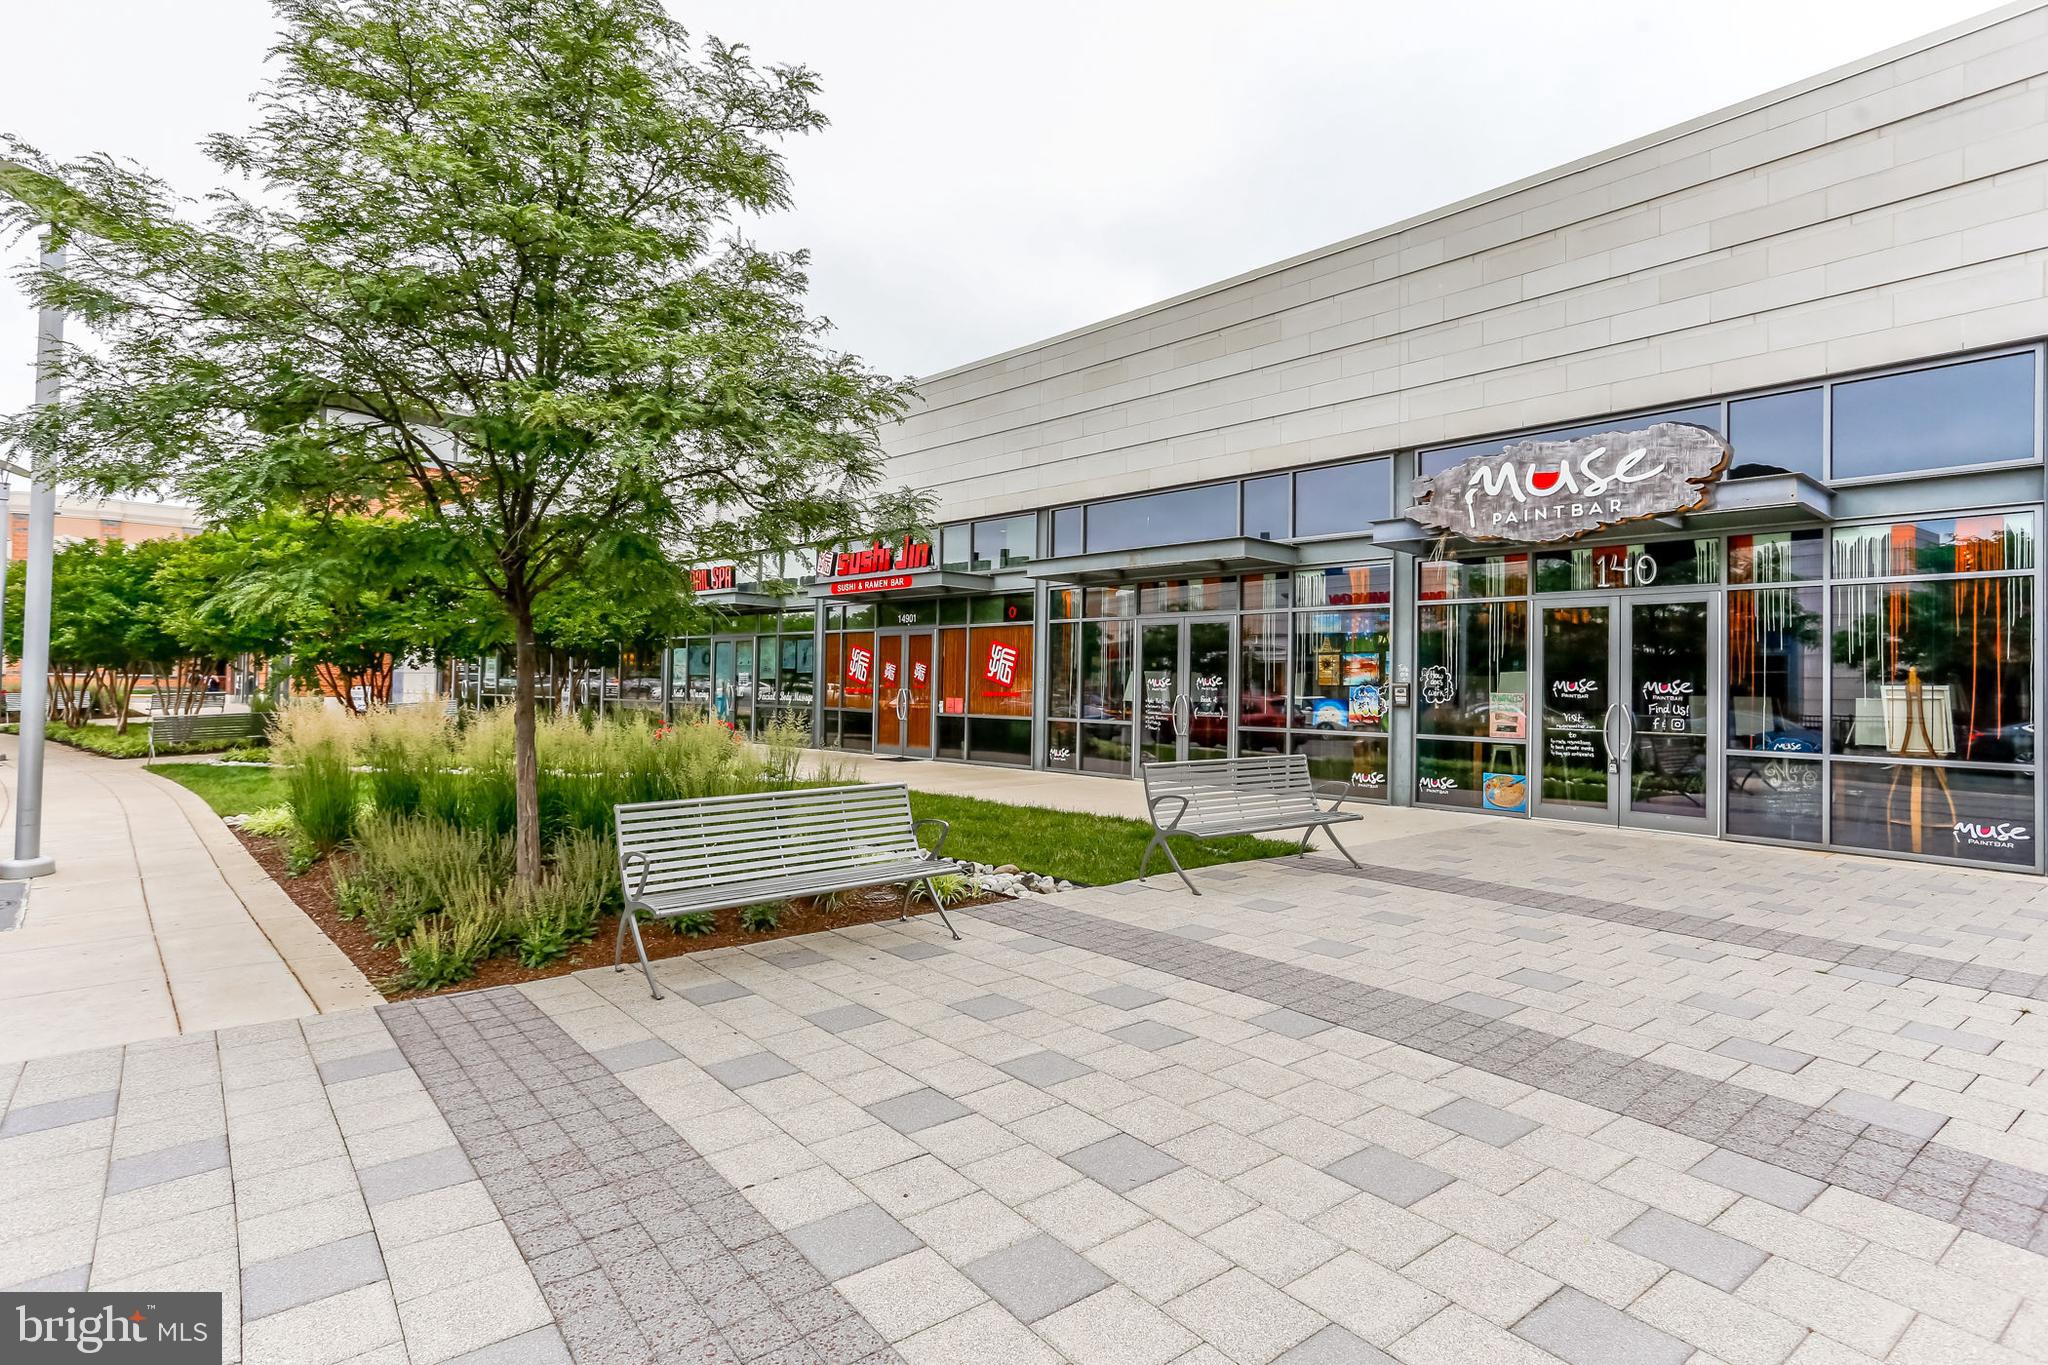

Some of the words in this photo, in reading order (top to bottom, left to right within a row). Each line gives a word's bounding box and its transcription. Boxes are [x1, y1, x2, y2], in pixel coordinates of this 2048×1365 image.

[1492, 499, 1622, 526] PAINTBAR
[1596, 554, 1657, 588] 140
[711, 566, 732, 590] SPA
[864, 579, 888, 589] RAMEN
[890, 578, 904, 586] BAR
[897, 614, 917, 623] 14901
[1648, 703, 1670, 715] Find
[1967, 838, 2015, 849] PAINTBAR
